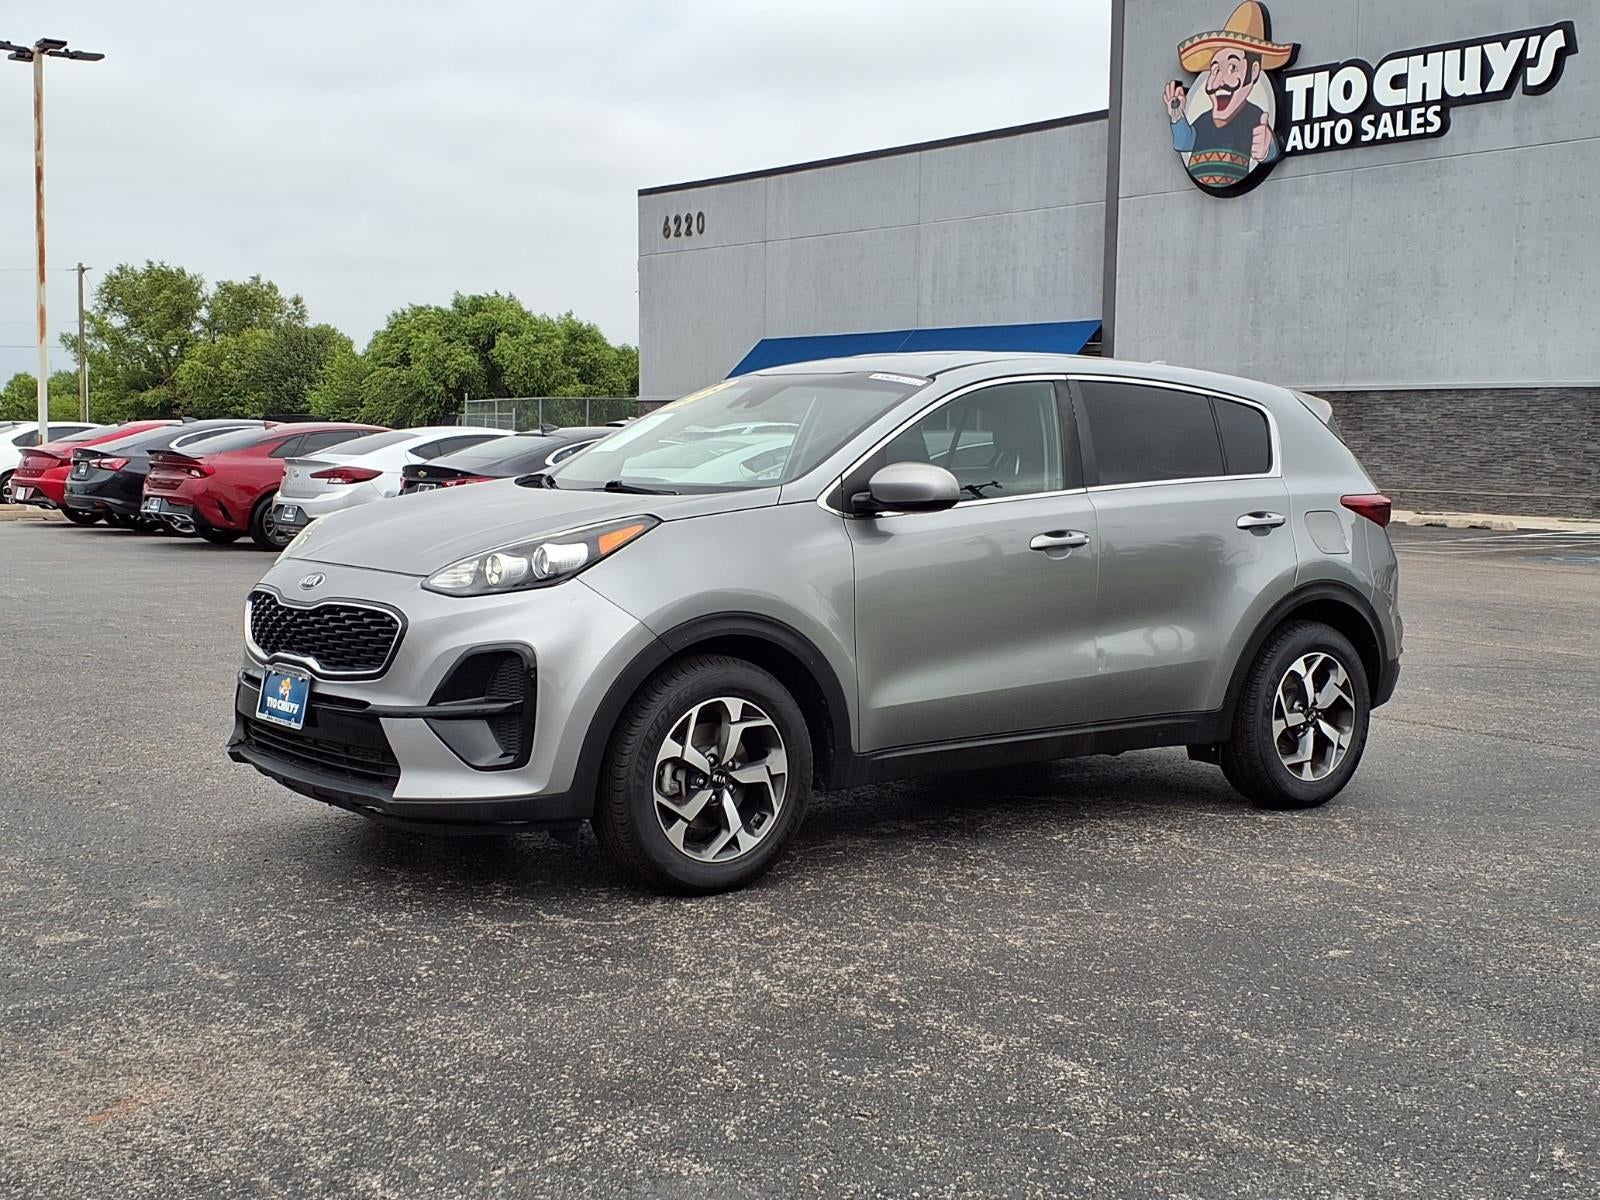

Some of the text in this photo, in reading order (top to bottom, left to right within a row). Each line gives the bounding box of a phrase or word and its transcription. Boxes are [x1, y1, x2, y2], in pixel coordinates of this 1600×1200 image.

[1285, 29, 1566, 121] TIO CHUY'S
[1285, 105, 1442, 152] AUTO SALES
[662, 211, 706, 240] 6220
[267, 696, 278, 709] TIO
[712, 774, 726, 784] KIA
